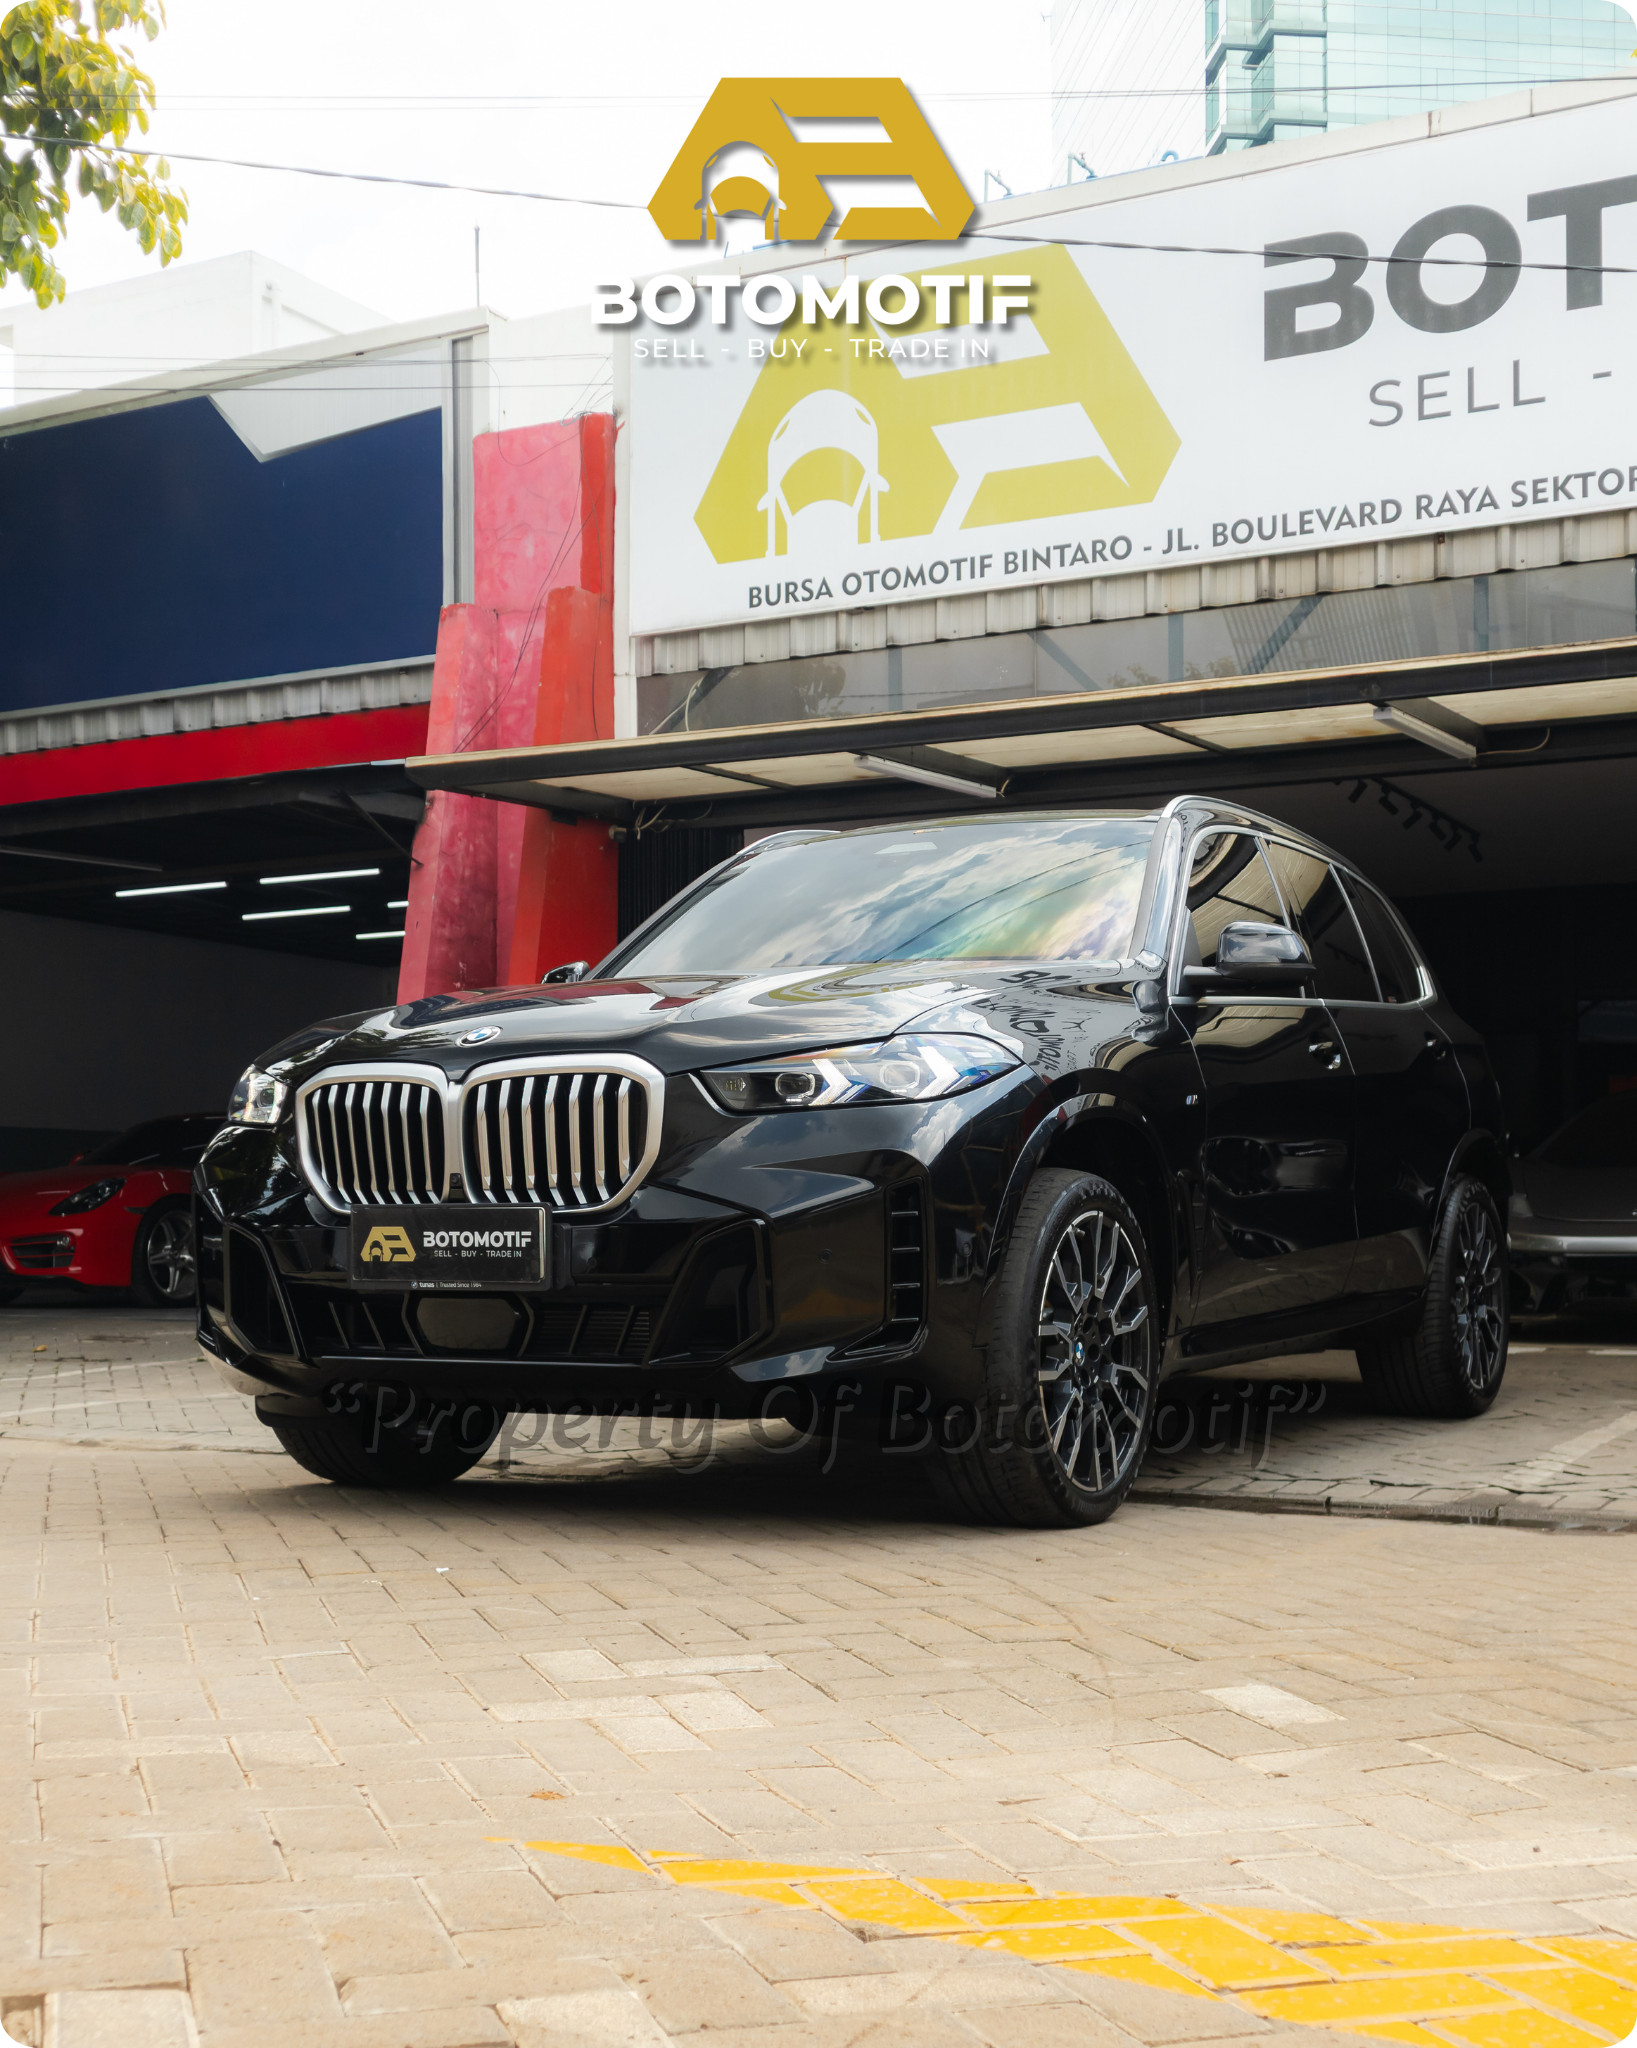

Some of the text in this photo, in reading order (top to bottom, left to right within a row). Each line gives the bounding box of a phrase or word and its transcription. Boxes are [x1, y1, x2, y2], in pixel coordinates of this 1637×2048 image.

[1368, 359, 1546, 427] SELL
[748, 577, 833, 608] BURSA
[842, 554, 993, 595] OTOMOTIF
[1004, 535, 1132, 575] BINTARO
[1162, 527, 1199, 555] JL.
[1212, 499, 1401, 547] BOULEVARD
[1416, 485, 1500, 520] RAYA
[423, 1231, 532, 1248] BOTOMOTIF
[434, 1250, 452, 1258] SELL
[461, 1250, 477, 1258] BUY
[486, 1250, 512, 1258] TRADE
[513, 1250, 522, 1258] IN
